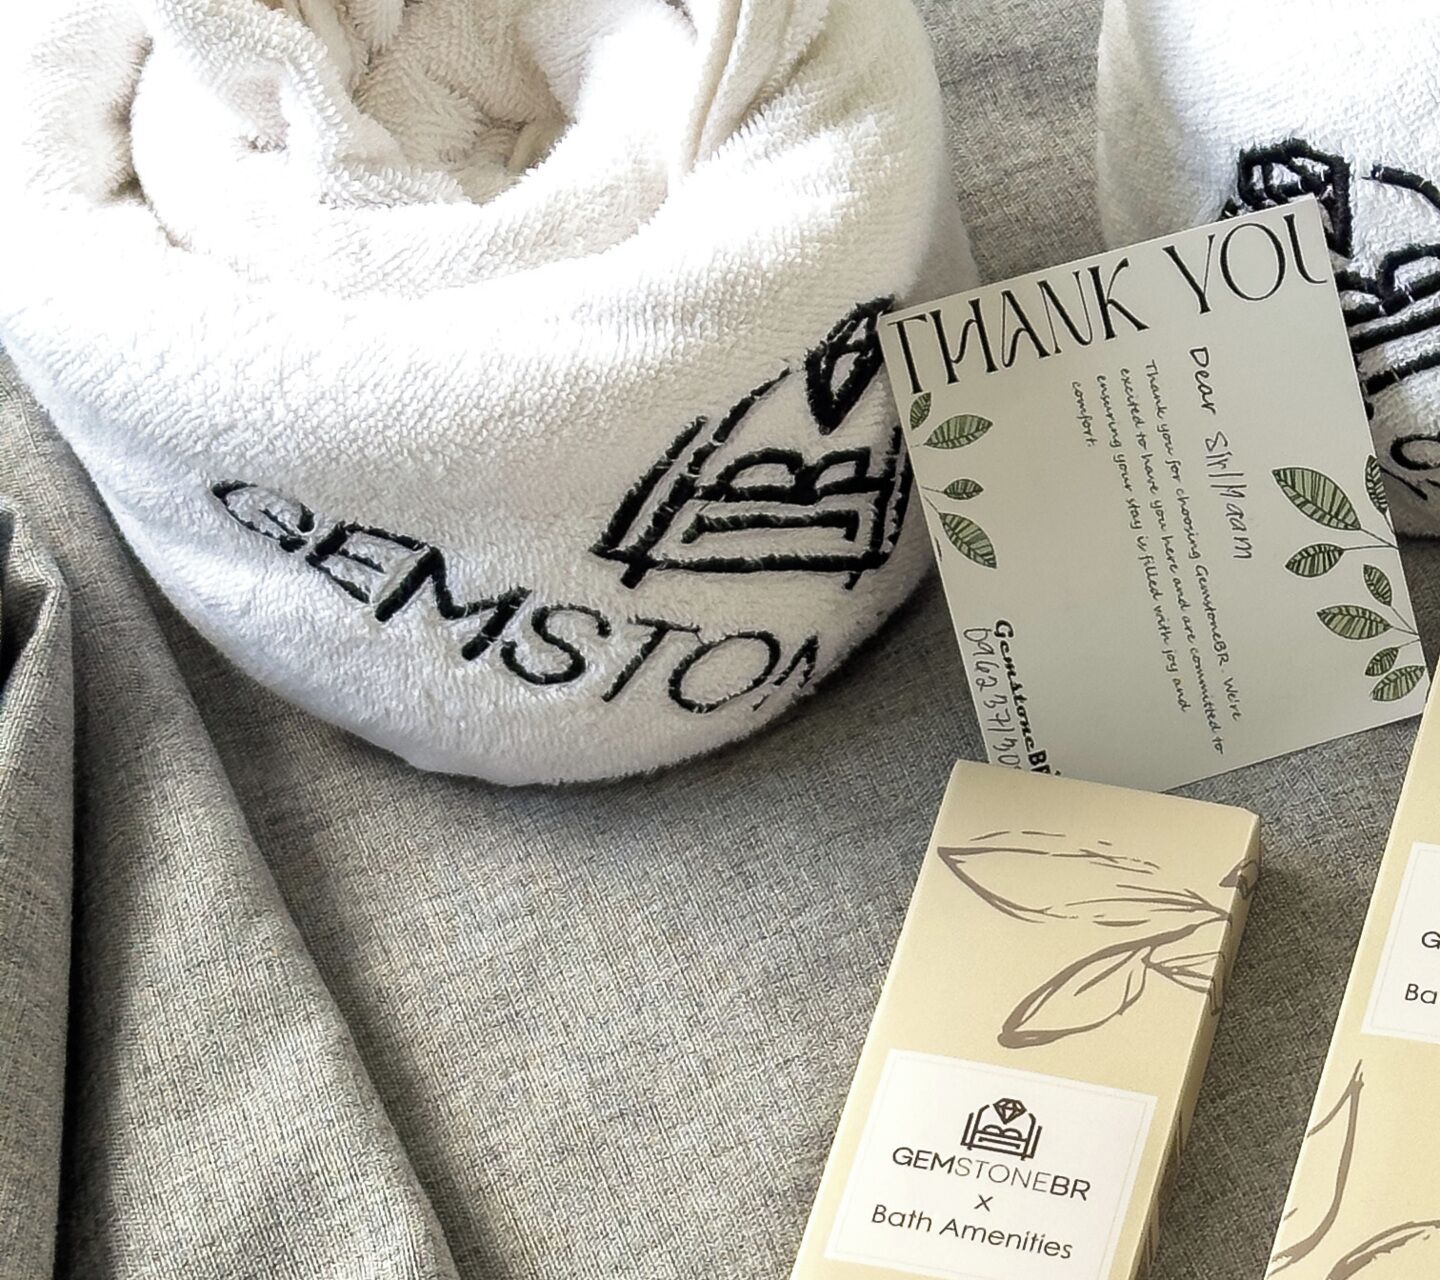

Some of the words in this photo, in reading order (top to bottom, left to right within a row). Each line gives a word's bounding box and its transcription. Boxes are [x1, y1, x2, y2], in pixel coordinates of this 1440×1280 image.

[887, 257, 1150, 394] THANK
[1120, 368, 1145, 430] excited
[1190, 347, 1216, 415] Dear
[1071, 381, 1098, 448] comfort.
[1096, 375, 1122, 449] ensuring
[1136, 432, 1147, 451] to
[1113, 453, 1133, 493] your
[1141, 453, 1159, 496] have
[1125, 497, 1143, 530] stay
[1150, 500, 1166, 531] you
[1137, 536, 1147, 554] is
[1145, 359, 1168, 420] Thank
[1157, 423, 1173, 456] you
[1165, 459, 1181, 480] for
[1176, 487, 1201, 560] choosing
[1224, 677, 1242, 721] We're
[1161, 535, 1177, 574] here
[1138, 555, 1163, 601] filled
[1172, 577, 1191, 612] and
[1153, 605, 1169, 645] with
[1182, 616, 1196, 644] are
[1162, 648, 1178, 674] joy
[1172, 677, 1191, 713] and
[1190, 647, 1221, 733] committed
[1212, 736, 1224, 755] to
[892, 1146, 1091, 1201] GEMSTONEBR
[871, 1204, 933, 1233] Bath
[939, 1218, 1073, 1260] Amenities
